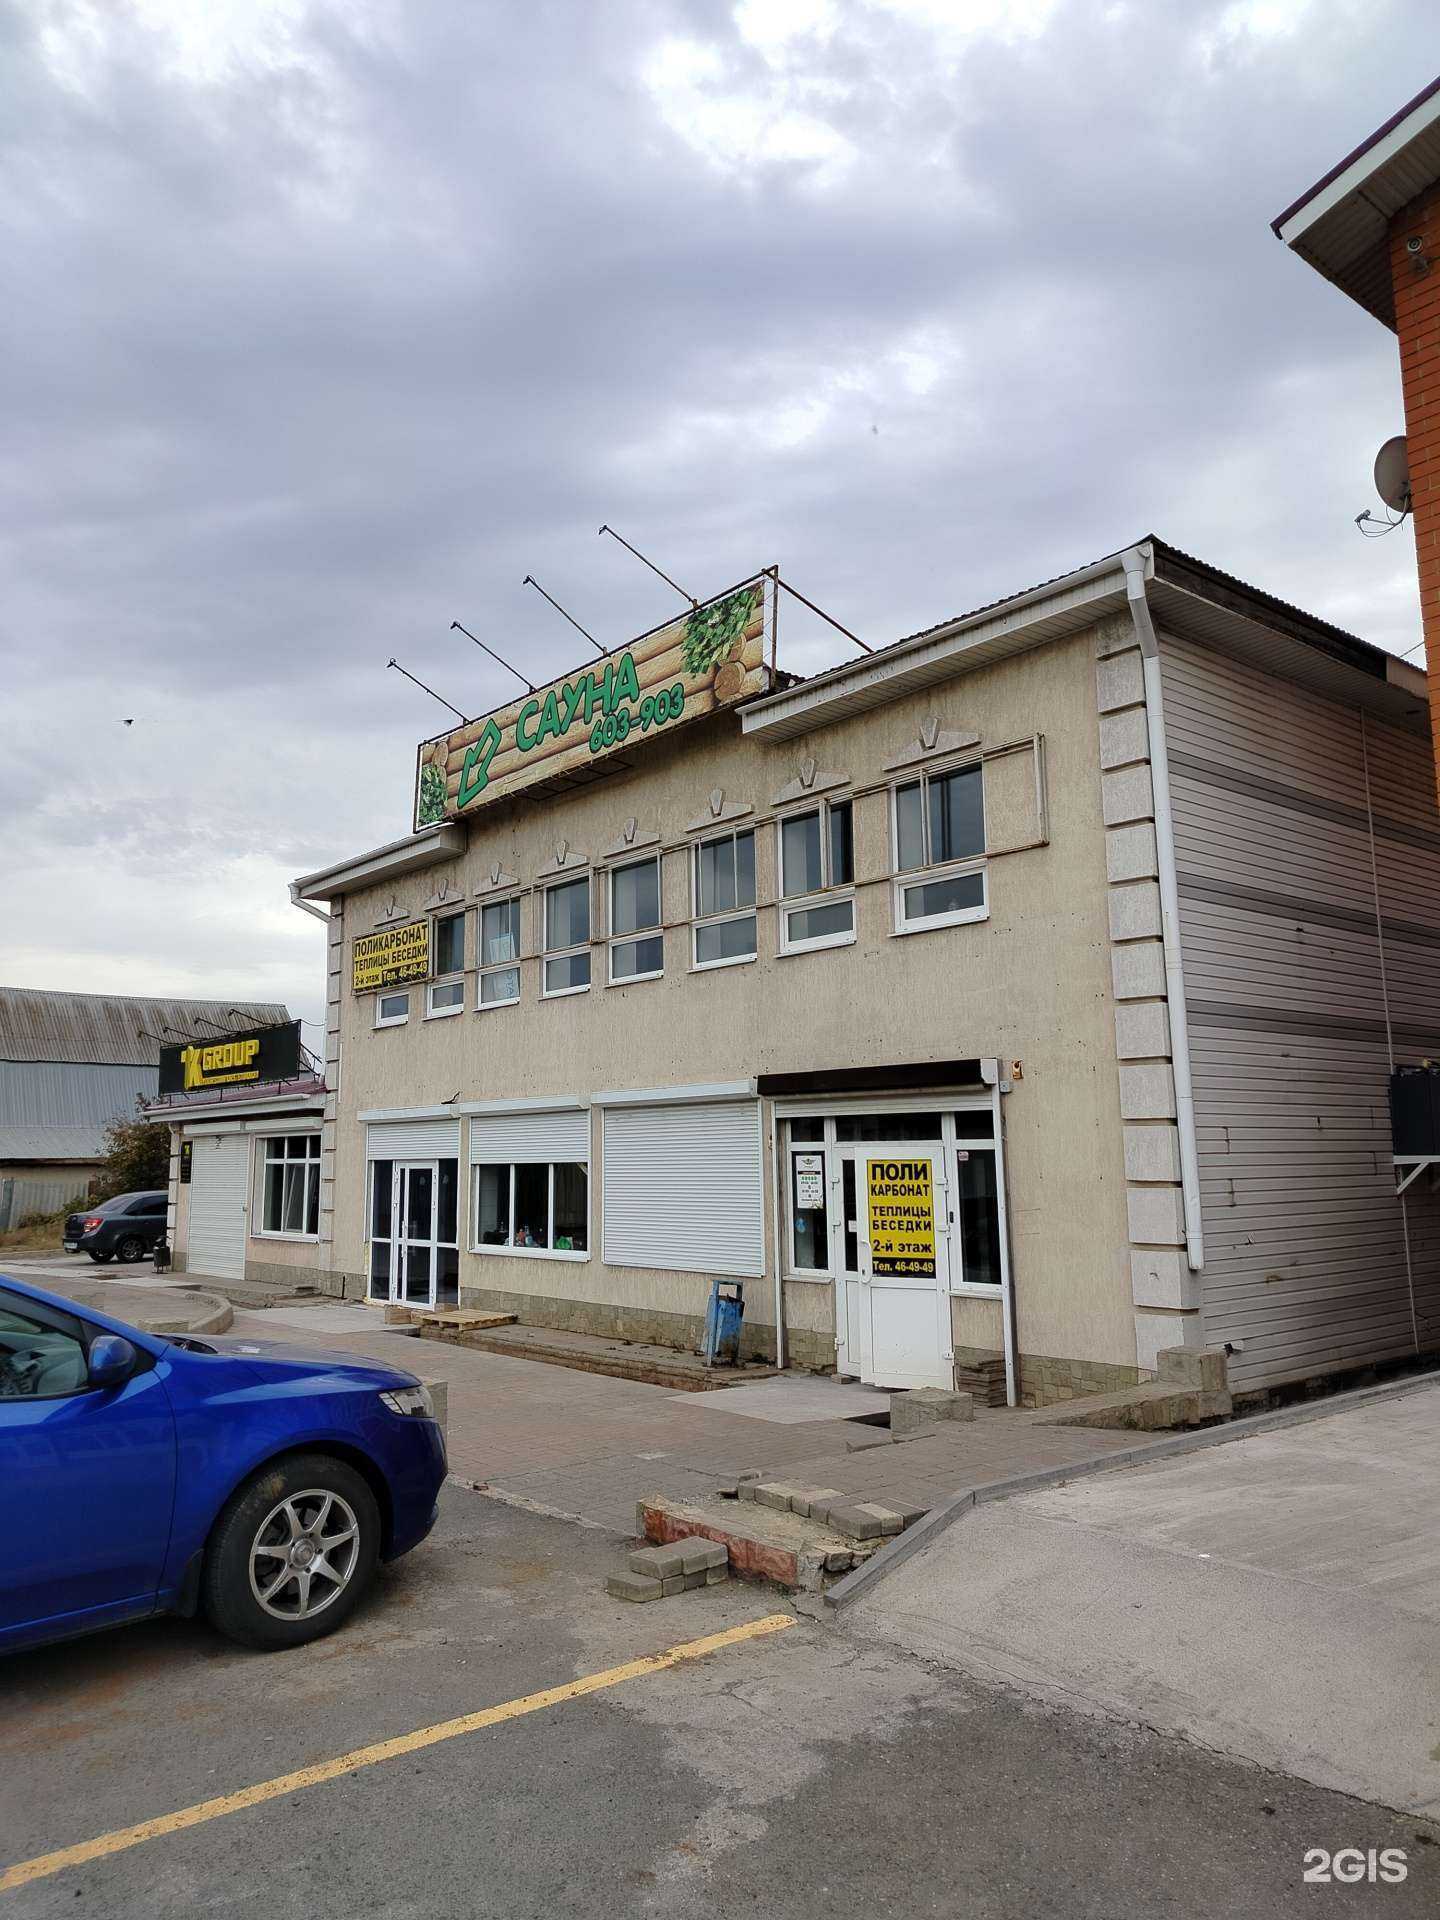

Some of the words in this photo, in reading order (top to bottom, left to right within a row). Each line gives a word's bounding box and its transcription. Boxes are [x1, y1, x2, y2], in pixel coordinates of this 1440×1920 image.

[516, 652, 640, 751] САУНА
[589, 683, 685, 753] 603-903
[355, 924, 428, 957] ПОЛИКАРБОНАТ
[355, 953, 390, 972] ТЕПЛИЦЫ
[392, 943, 428, 963] БЕСЕДКИ
[203, 1039, 260, 1071] GROUP
[871, 1163, 928, 1180] ПОЛИ
[871, 1184, 929, 1196] КАРБОНАТ
[872, 1206, 931, 1219] ТЕПЛИЦЫ
[872, 1220, 932, 1233] БЕСЕДКИ
[873, 1239, 893, 1253] 2-й
[898, 1242, 932, 1253] этаж
[873, 1261, 893, 1271] Тел.
[895, 1261, 934, 1273] 46-49-49
